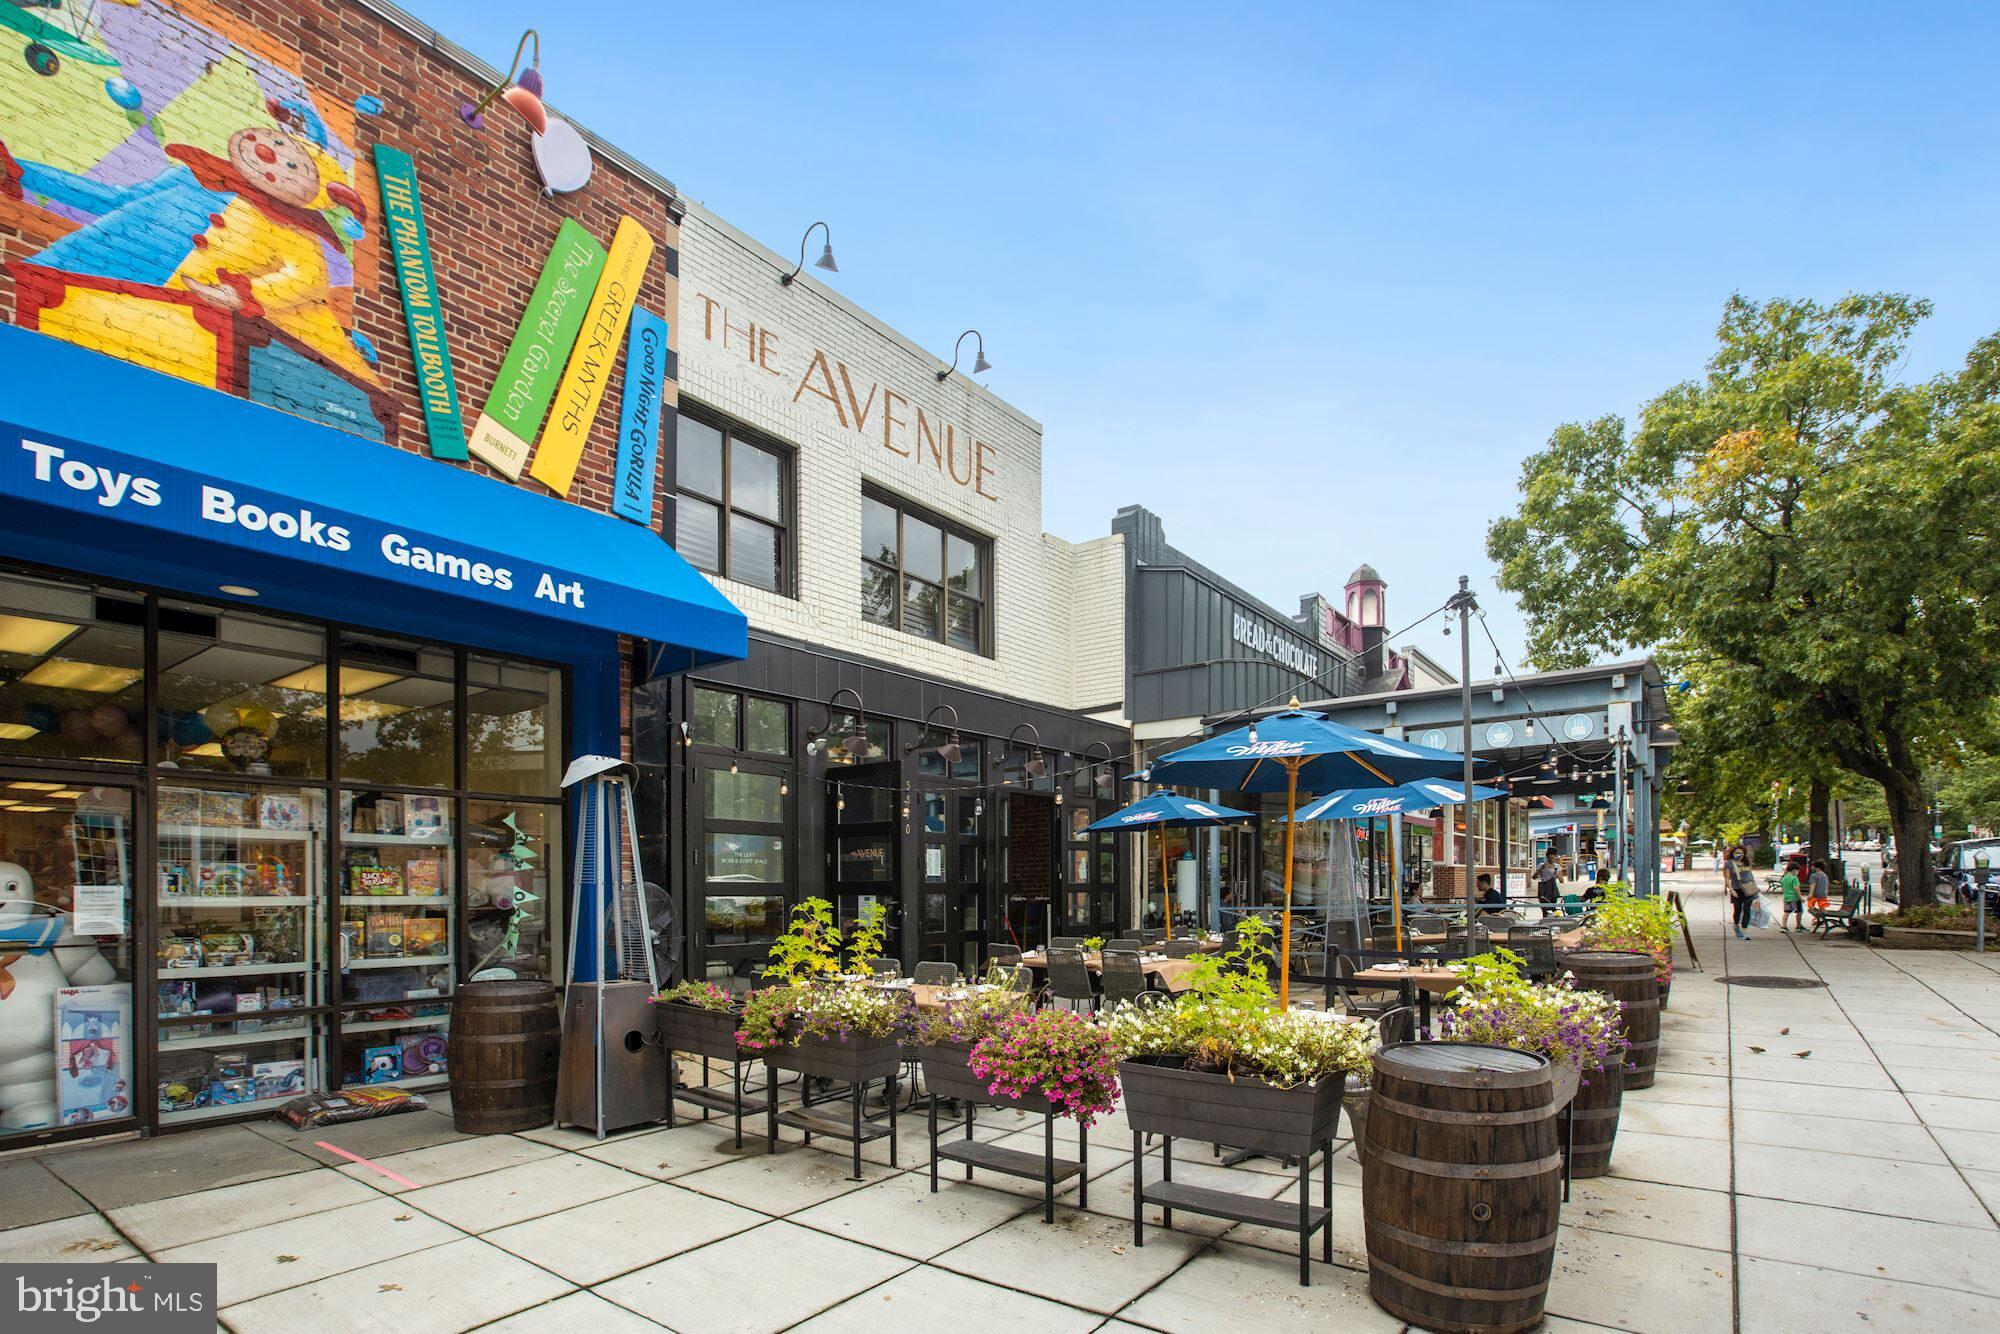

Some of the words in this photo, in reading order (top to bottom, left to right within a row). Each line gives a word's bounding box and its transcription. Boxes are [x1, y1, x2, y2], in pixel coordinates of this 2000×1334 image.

[383, 173, 415, 216] THE
[391, 214, 433, 309] PHANTOM
[563, 241, 594, 279] The
[536, 276, 577, 345] Secret
[587, 280, 626, 357] GREEK
[411, 312, 453, 415] TOLLBOOTH
[502, 343, 551, 421] Garden
[562, 355, 601, 436] MYTHS
[696, 292, 781, 377] THE
[793, 348, 998, 502] AVENUE
[483, 432, 518, 461] BURNETT
[21, 438, 162, 508] Toys
[201, 484, 351, 552] Books
[380, 533, 514, 591] Games
[534, 572, 585, 609] Art
[1352, 797, 1405, 815] Miller
[361, 872, 382, 880] RACE
[856, 848, 885, 859] AVENUE
